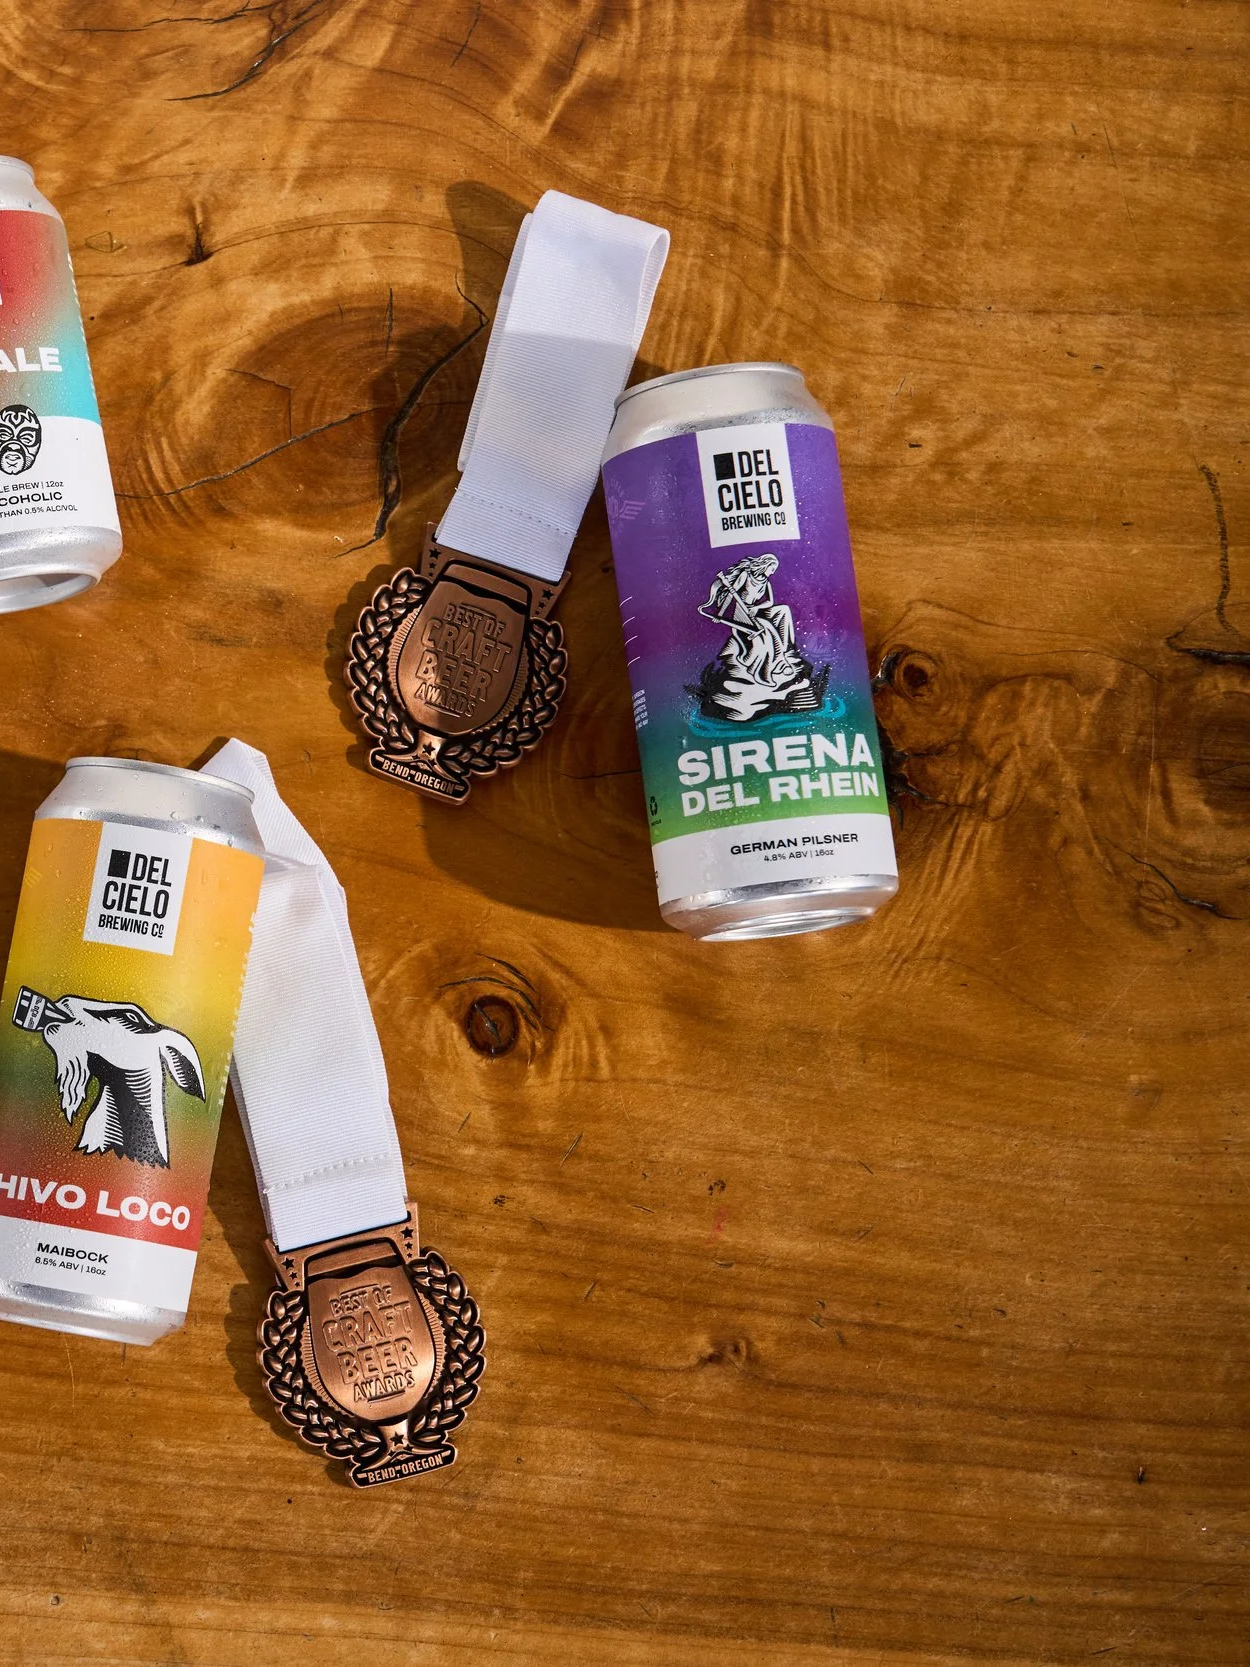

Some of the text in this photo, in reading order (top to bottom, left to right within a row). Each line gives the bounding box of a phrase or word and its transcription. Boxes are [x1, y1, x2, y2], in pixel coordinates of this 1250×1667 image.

[738, 449, 779, 478] DEL
[12, 481, 40, 492] BREW
[46, 480, 64, 488] 12oz
[718, 479, 783, 512] CIELO
[24, 506, 44, 515] 0.5%
[721, 512, 772, 531] BREWING
[443, 603, 506, 638] BEST OF
[421, 617, 512, 672] CRAFT
[415, 649, 493, 702] BEER
[414, 682, 475, 717] AWARDS
[677, 733, 875, 786] SIRENA
[413, 771, 454, 795] OREGON
[681, 771, 879, 817] DEL RHEIN
[730, 833, 858, 855] GERMAN PILSNER
[764, 848, 834, 862] 4.8% ABV 16oz
[131, 853, 172, 887] DEL
[102, 880, 170, 919] CIELO
[97, 913, 149, 935] BREWING
[96, 1190, 190, 1231] LOCO
[35, 1256, 106, 1276] 6.5% ABV 16oz
[37, 1242, 109, 1264] MAIBOCK
[330, 1285, 391, 1318] BEST OF
[322, 1301, 412, 1352] CRAFT
[337, 1337, 418, 1385] BEER
[353, 1370, 416, 1402] AWARDS
[401, 1454, 444, 1474] OREGON
